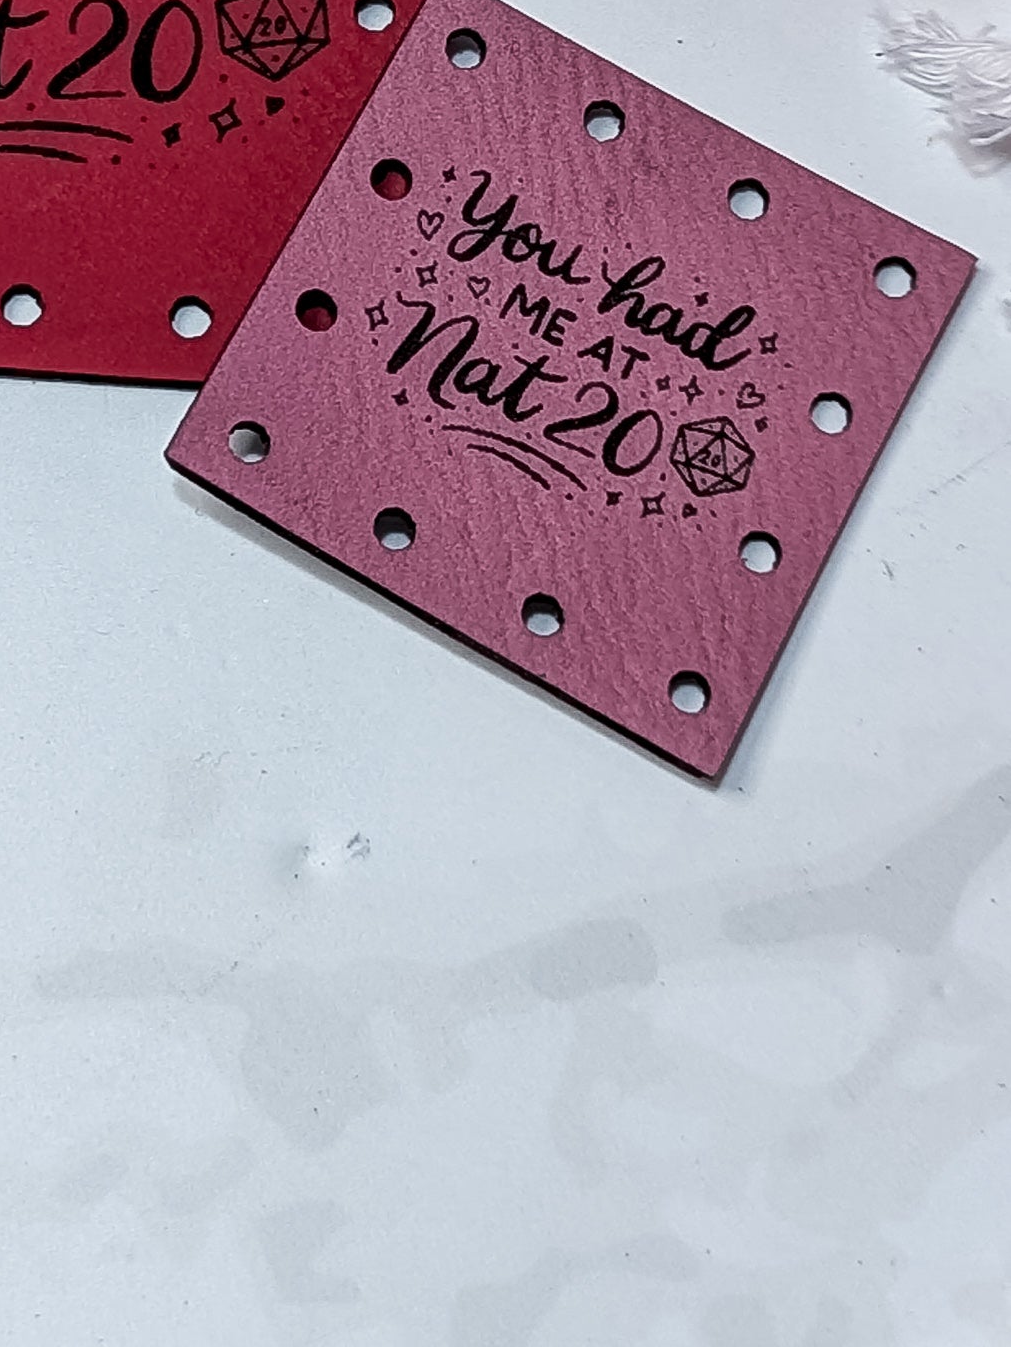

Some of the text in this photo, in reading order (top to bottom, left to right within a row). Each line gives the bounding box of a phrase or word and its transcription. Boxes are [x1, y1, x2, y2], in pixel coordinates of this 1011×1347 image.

[257, 15, 287, 37] 20
[447, 170, 757, 370] You had
[499, 283, 651, 379] ME AT
[386, 291, 664, 477] Nat 20
